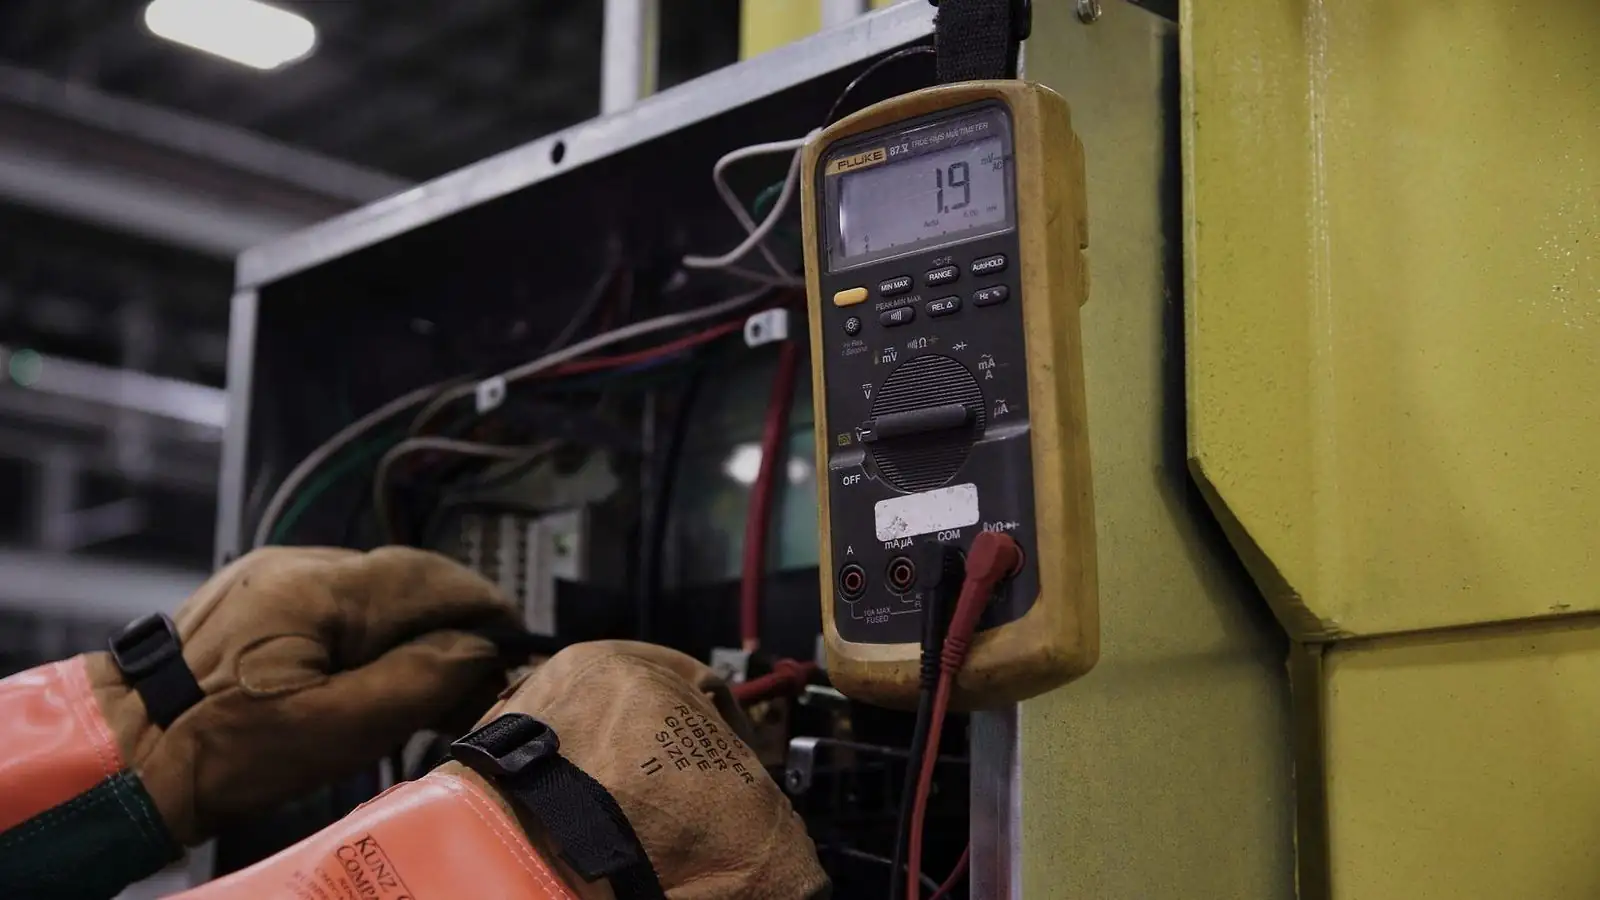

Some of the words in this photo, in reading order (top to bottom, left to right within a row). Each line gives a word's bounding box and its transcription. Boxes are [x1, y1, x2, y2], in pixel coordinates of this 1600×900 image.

[837, 152, 883, 170] FLUKE
[934, 161, 971, 214] 1.9
[972, 258, 1004, 272] AutoHOLD
[929, 269, 952, 281] RANGE
[881, 282, 893, 292] MIN
[894, 279, 908, 290] MAX
[932, 303, 945, 312] REL
[882, 351, 898, 364] mV
[978, 357, 996, 370] mA
[985, 369, 993, 380] A
[842, 474, 861, 486] OFF
[937, 529, 961, 542] COM
[846, 545, 854, 555] A
[867, 615, 889, 625] FUSED
[665, 716, 712, 772] GLOVE
[674, 704, 728, 771] RUBBER
[655, 731, 691, 771] SIZE
[716, 738, 755, 784] OVER
[354, 836, 397, 893] KUNZ
